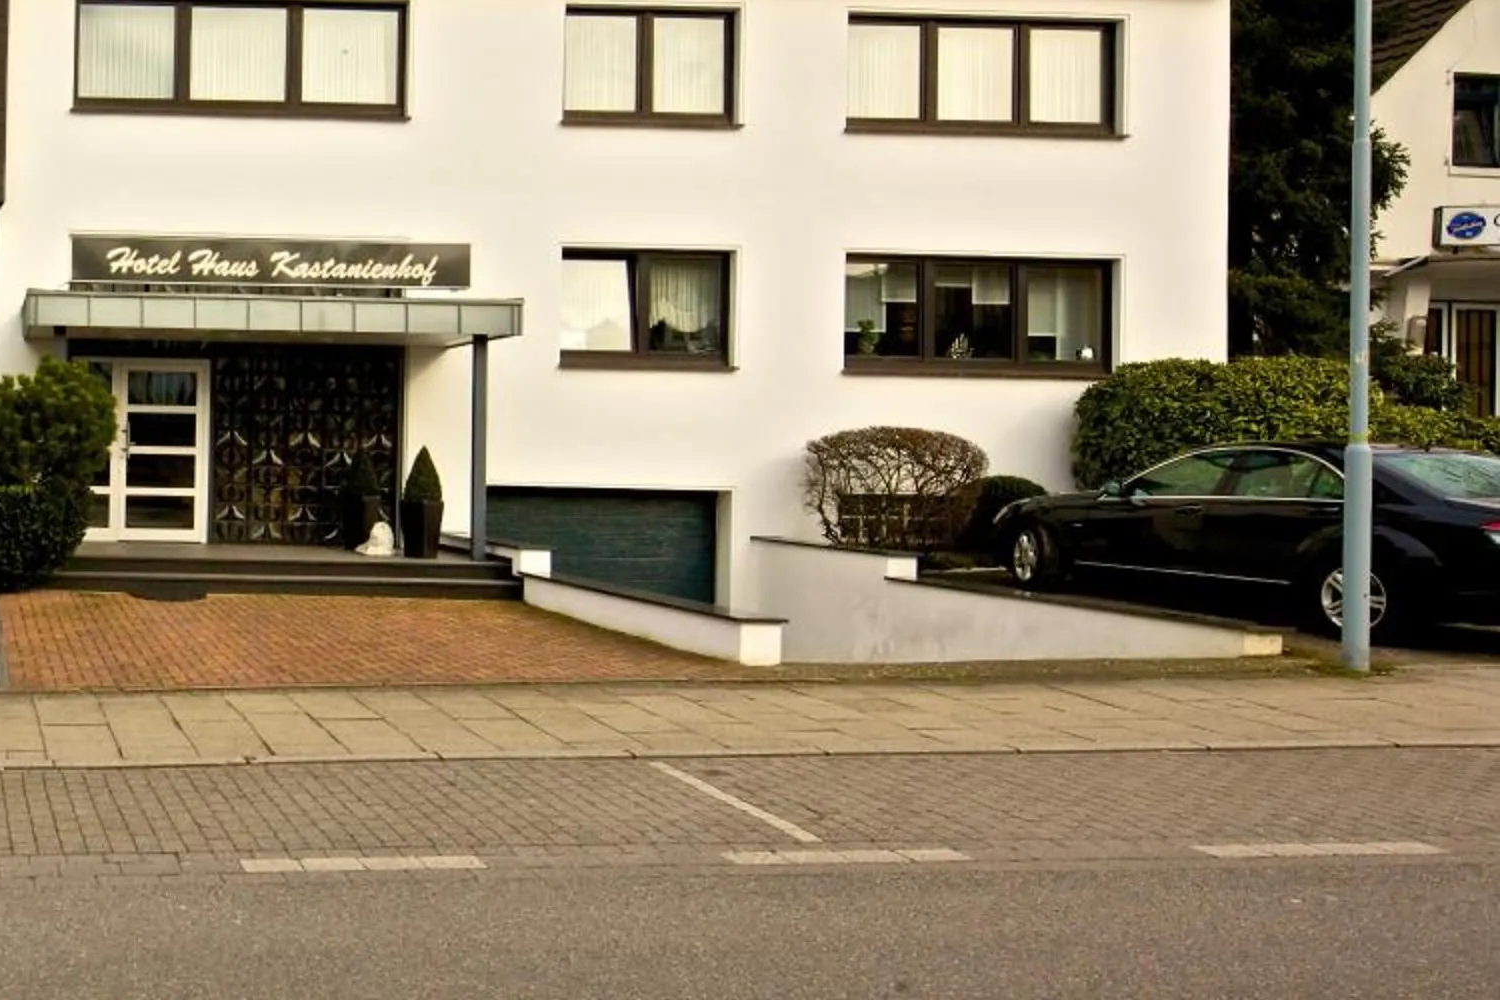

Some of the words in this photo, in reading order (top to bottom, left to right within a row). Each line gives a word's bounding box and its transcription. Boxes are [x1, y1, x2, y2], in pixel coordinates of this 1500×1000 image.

[106, 246, 182, 274] Hotel
[187, 248, 260, 277] Haus
[269, 250, 439, 287] Kastanienhof
